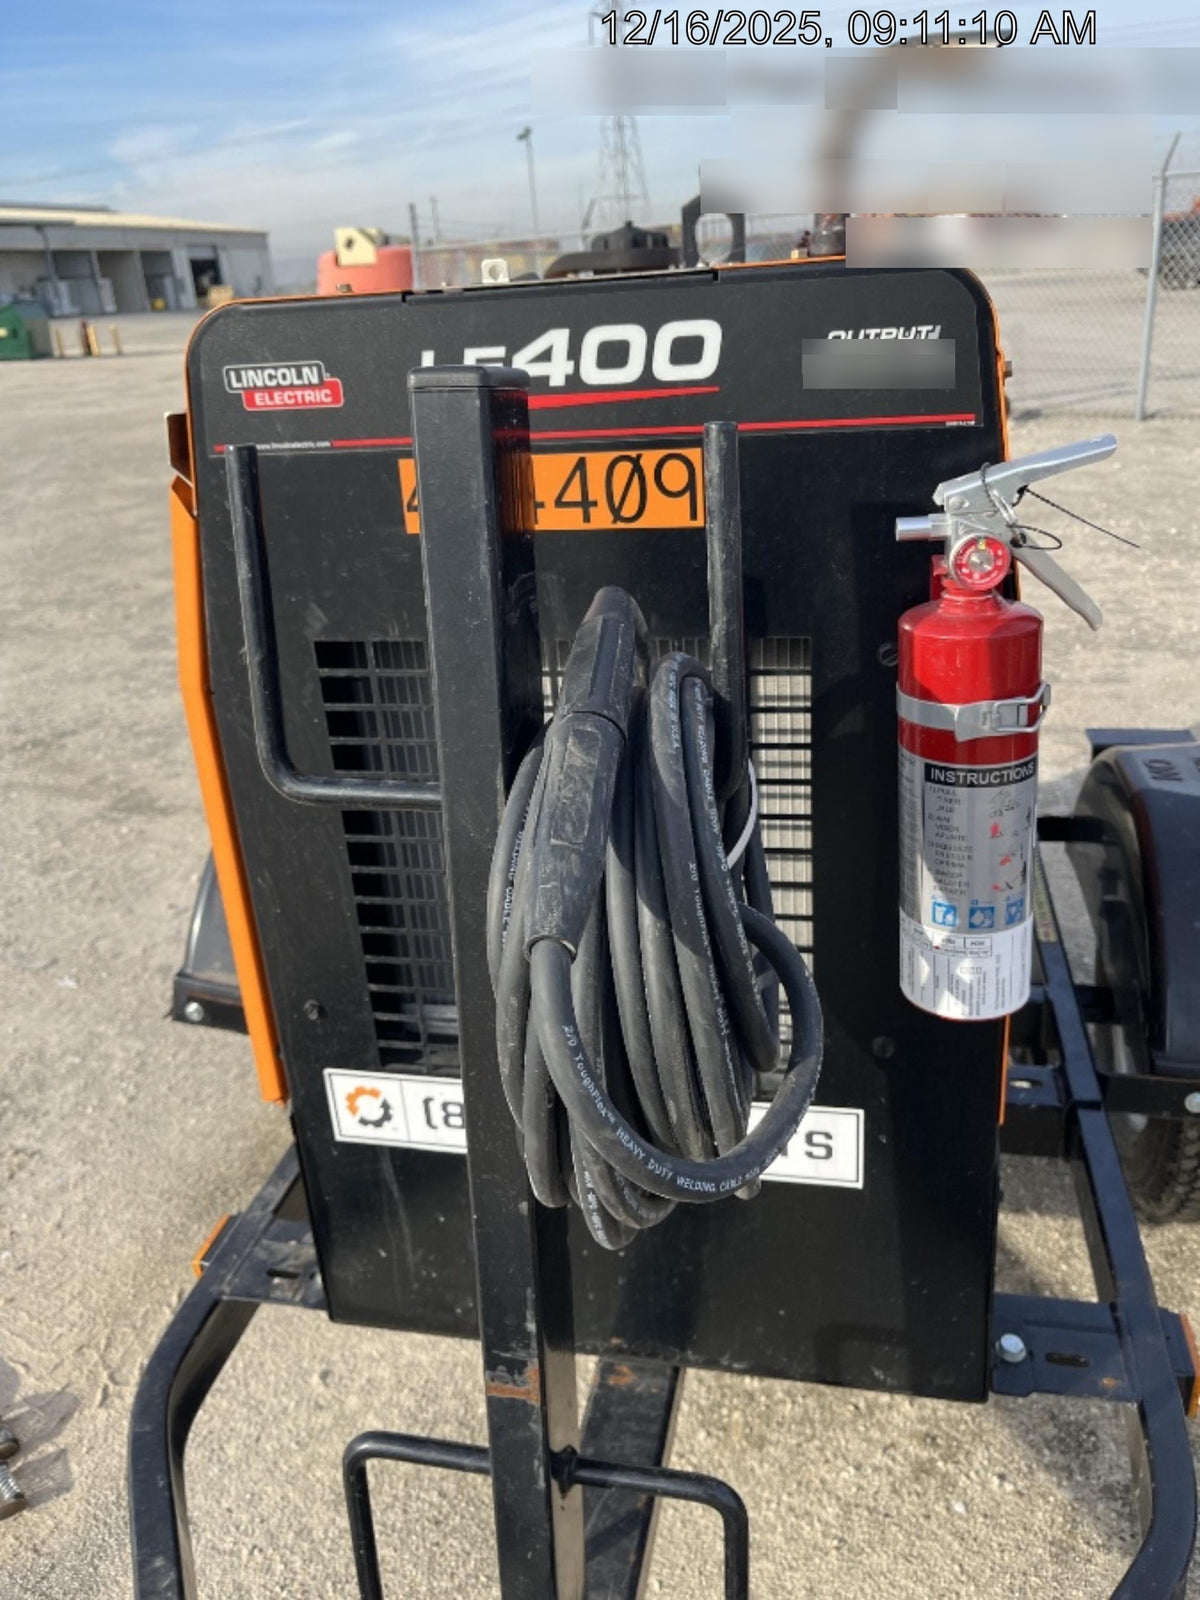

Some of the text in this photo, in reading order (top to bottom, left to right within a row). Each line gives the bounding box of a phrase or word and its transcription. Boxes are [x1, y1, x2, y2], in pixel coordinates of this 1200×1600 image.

[420, 319, 723, 387] 400
[229, 365, 320, 388] LINCOLN
[254, 388, 333, 406] ELECTRIC
[930, 761, 1035, 785] INSTRUCTIONS
[616, 1126, 646, 1160] HEAVY
[646, 1158, 674, 1180] DUTY
[676, 1178, 717, 1193] WELDING
